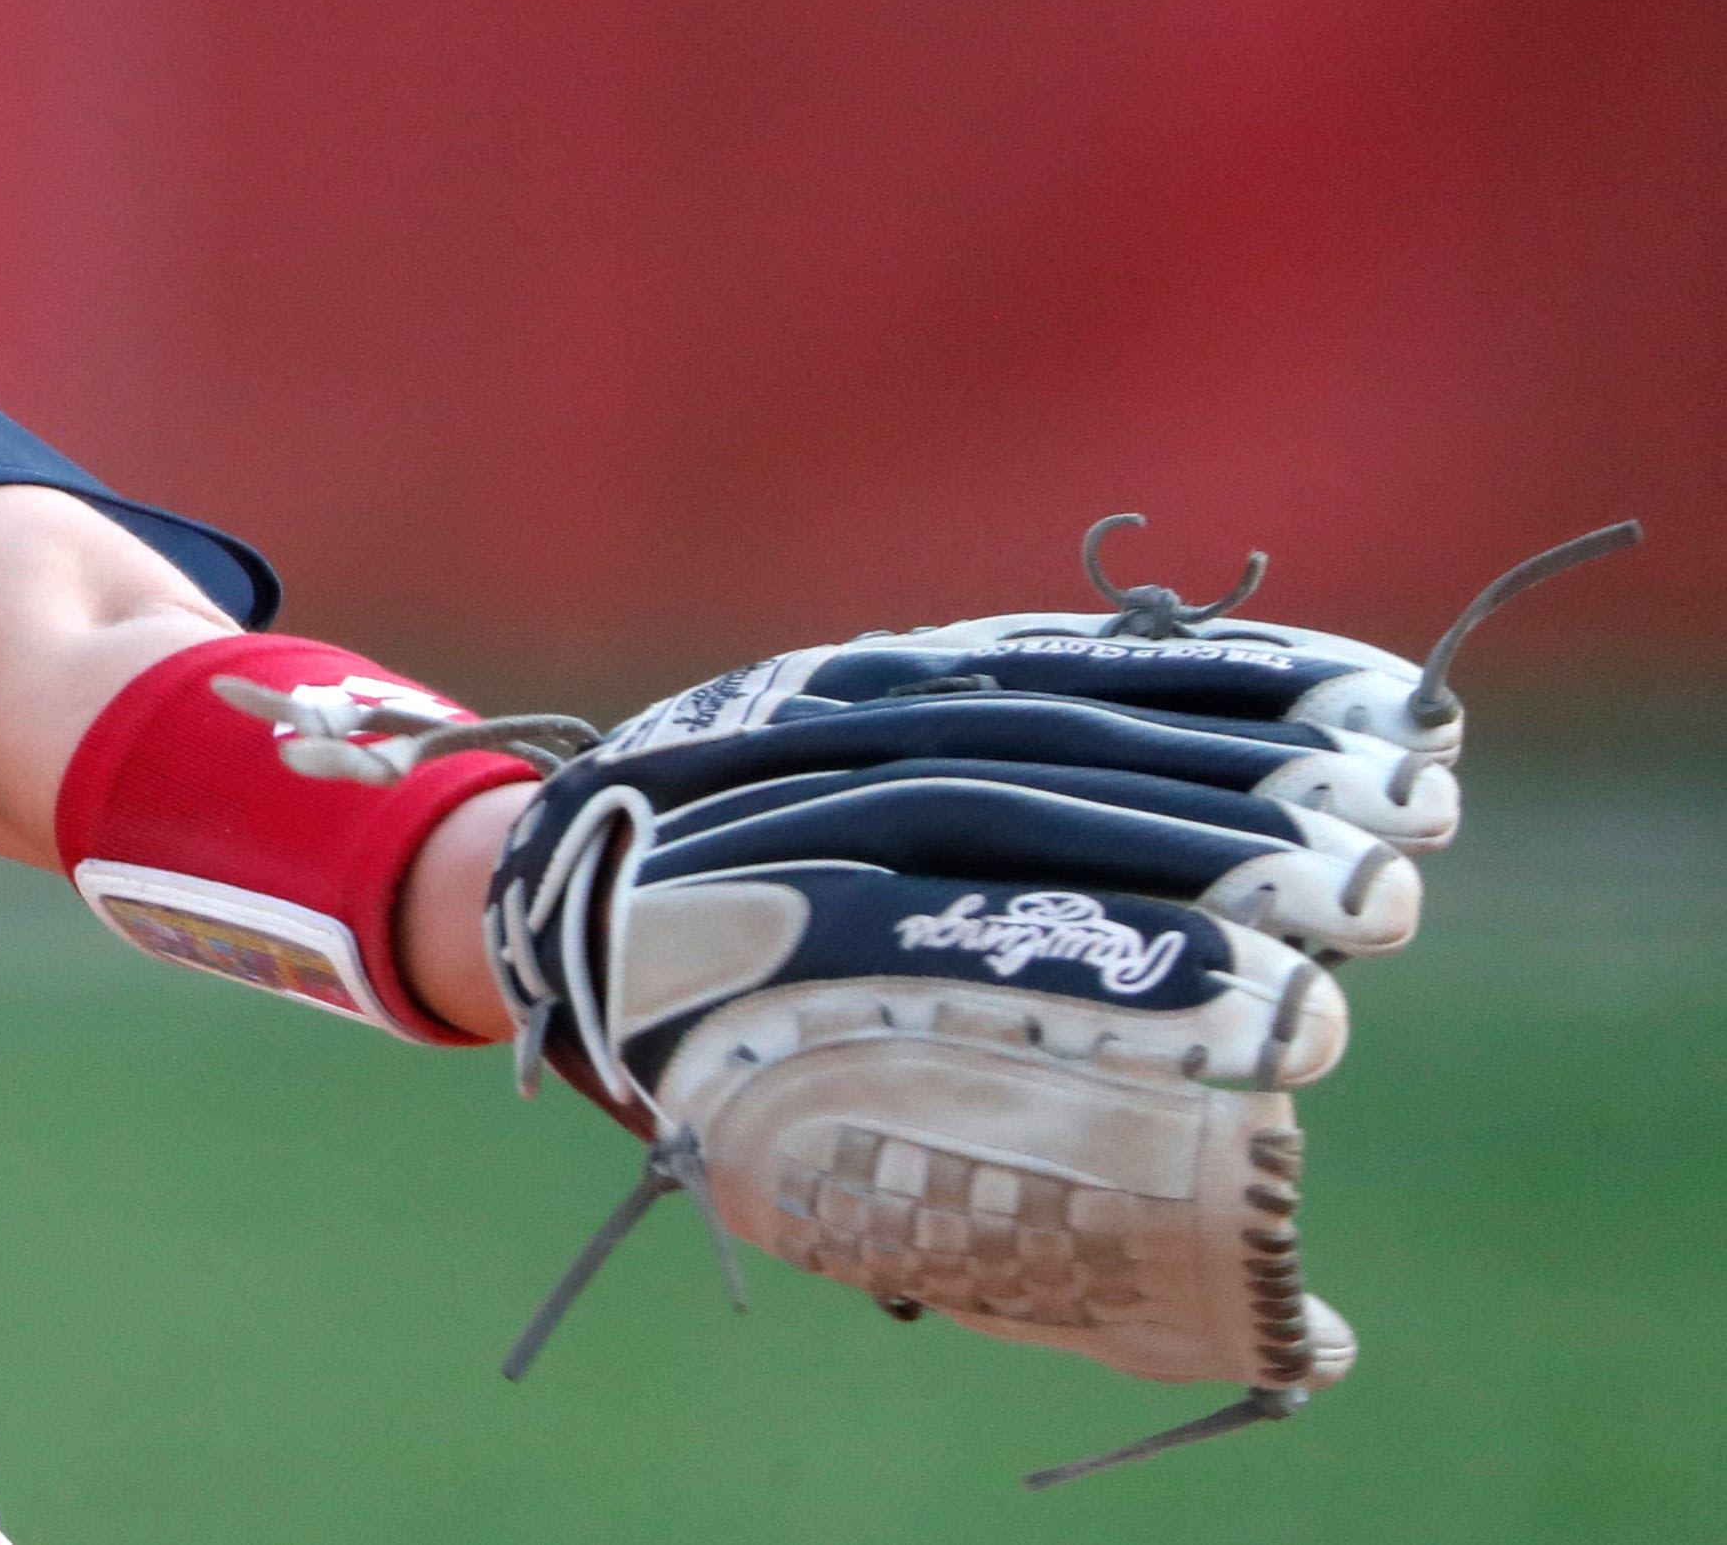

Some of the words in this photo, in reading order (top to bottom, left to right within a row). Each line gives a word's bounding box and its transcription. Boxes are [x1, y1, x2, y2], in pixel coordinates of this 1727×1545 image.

[1022, 639, 1130, 658] GLOVE
[1223, 650, 1294, 670] THE
[894, 893, 1187, 994] Rawlings
